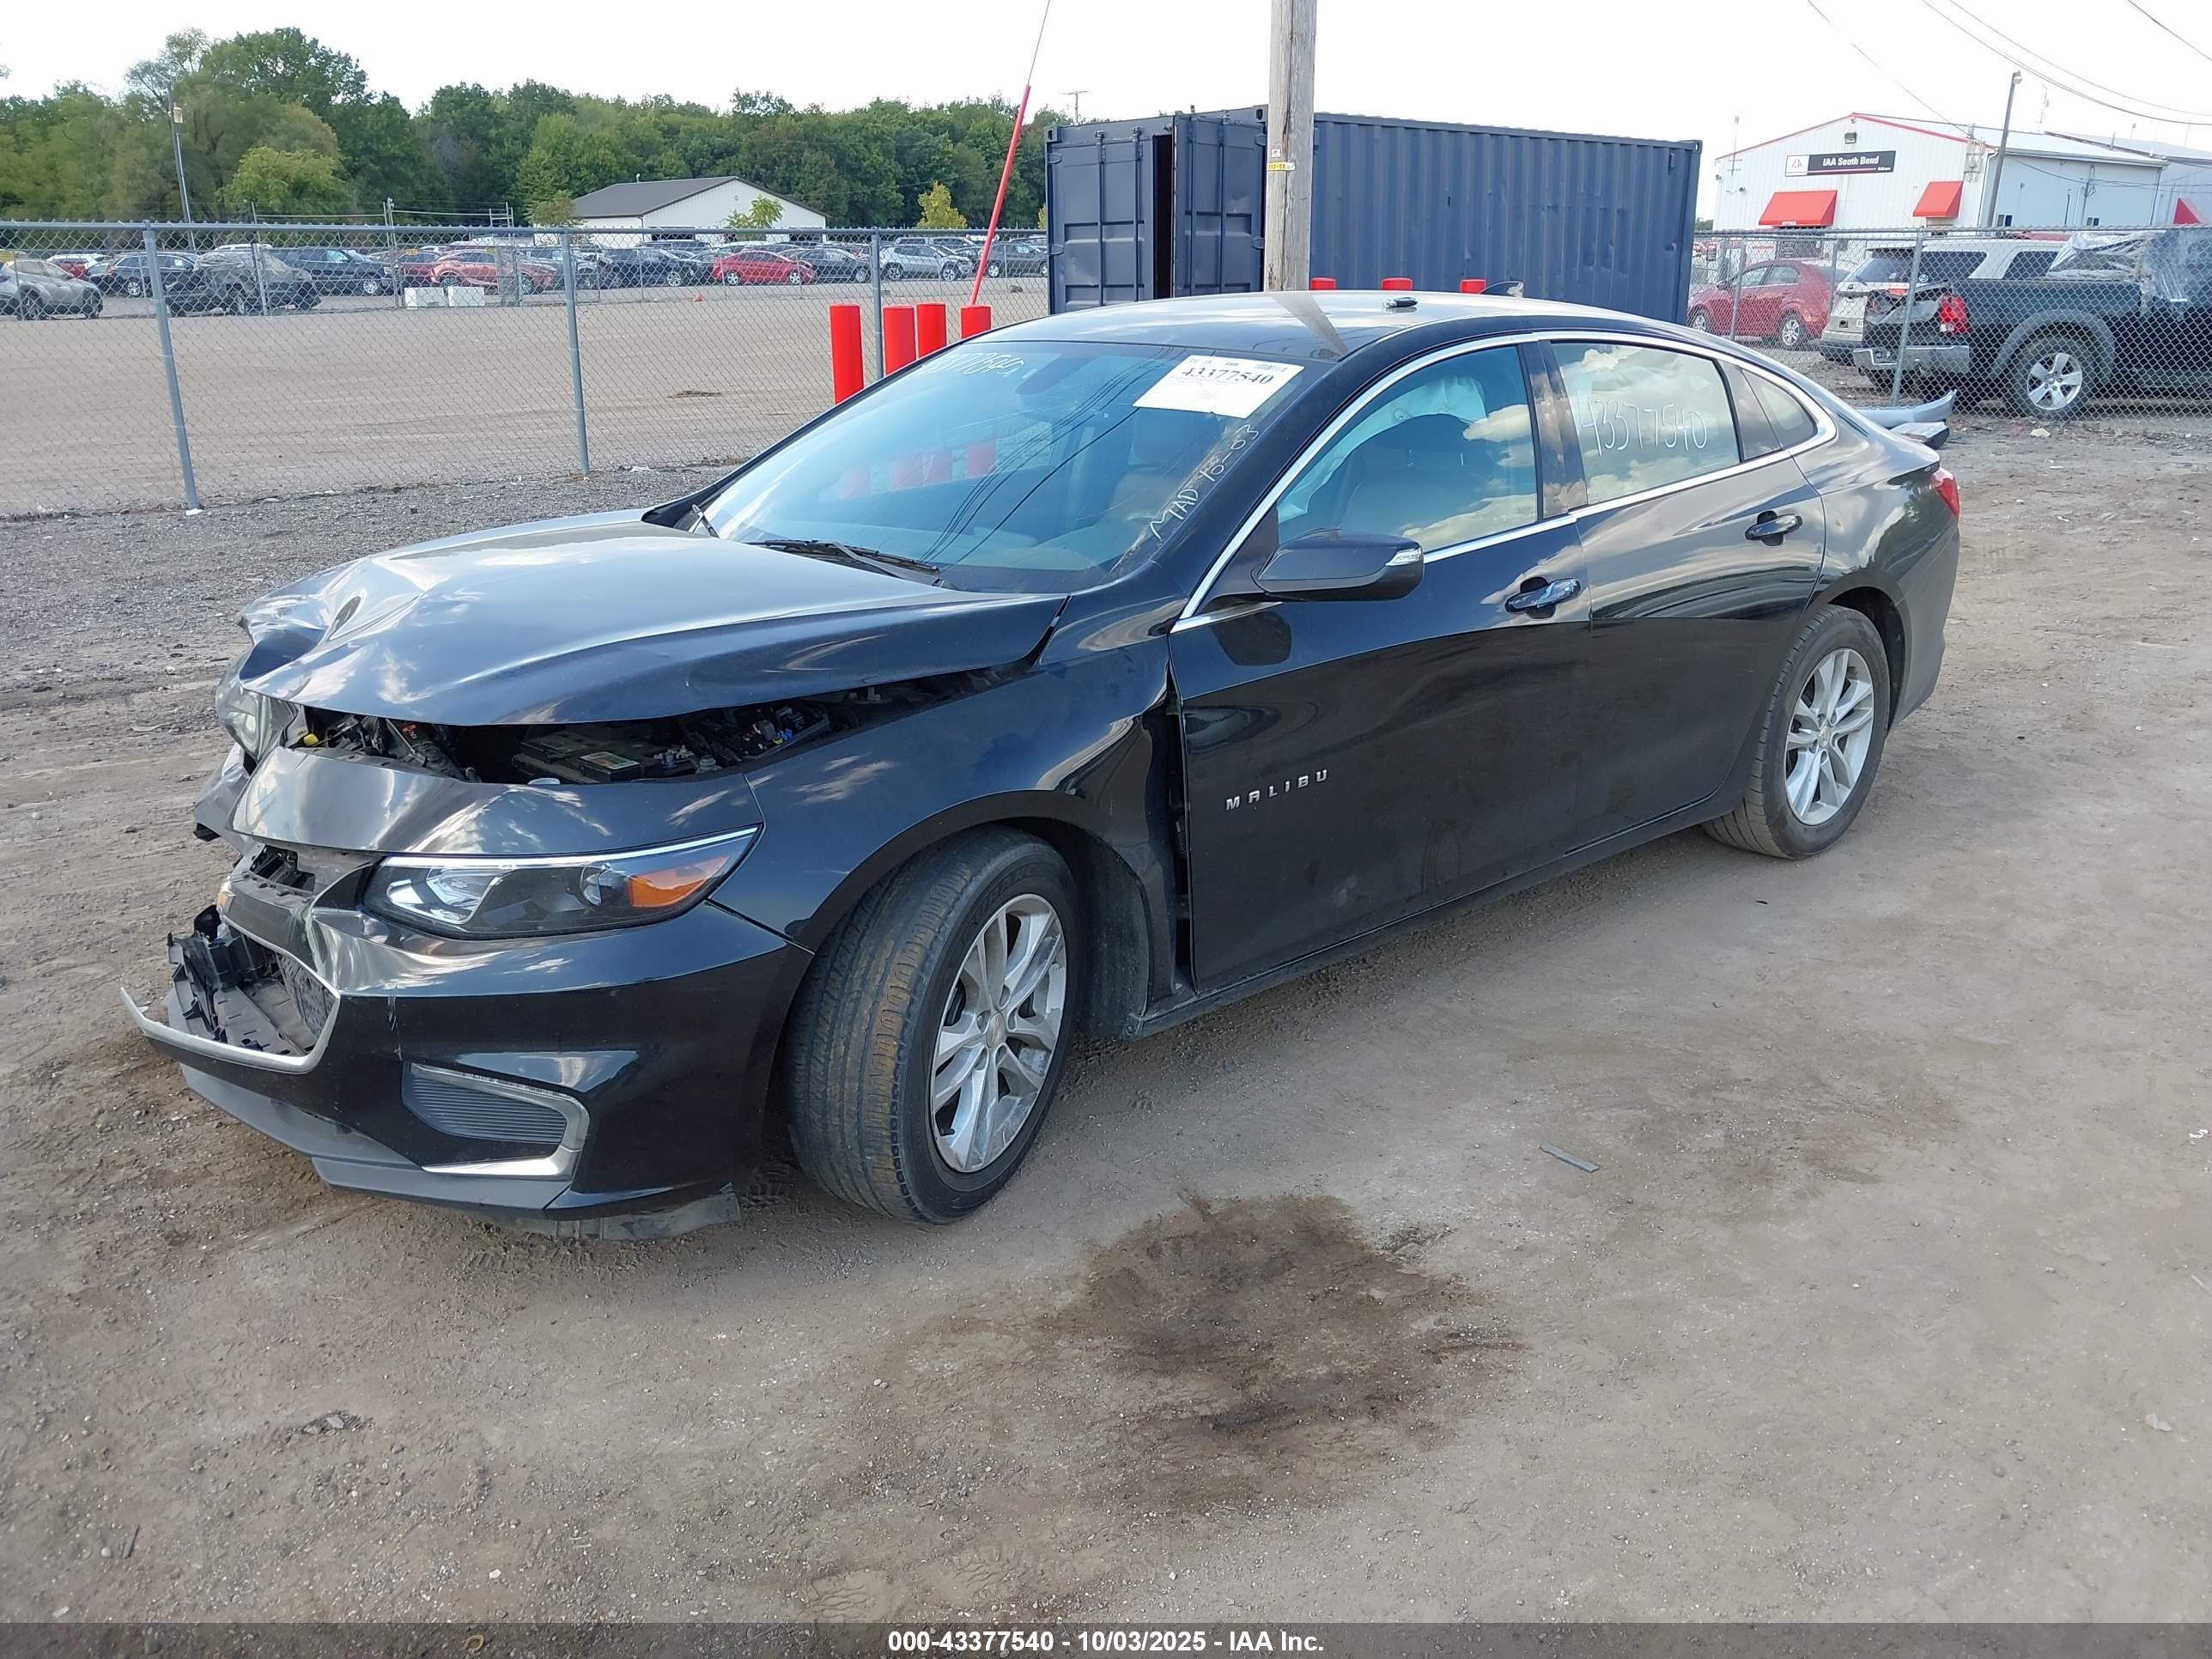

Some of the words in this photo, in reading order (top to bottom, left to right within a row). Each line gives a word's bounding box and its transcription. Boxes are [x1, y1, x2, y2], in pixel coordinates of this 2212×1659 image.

[1822, 157, 1837, 167] IAA
[1838, 156, 1858, 166] South
[1860, 155, 1879, 165] Bend
[915, 352, 1024, 377] 3377540
[1182, 367, 1274, 385] 43377540
[1577, 391, 1708, 457] 43377540
[1150, 489, 1199, 541] MAD
[1199, 424, 1260, 482] 10-03
[1225, 769, 1328, 811] MALIBU
